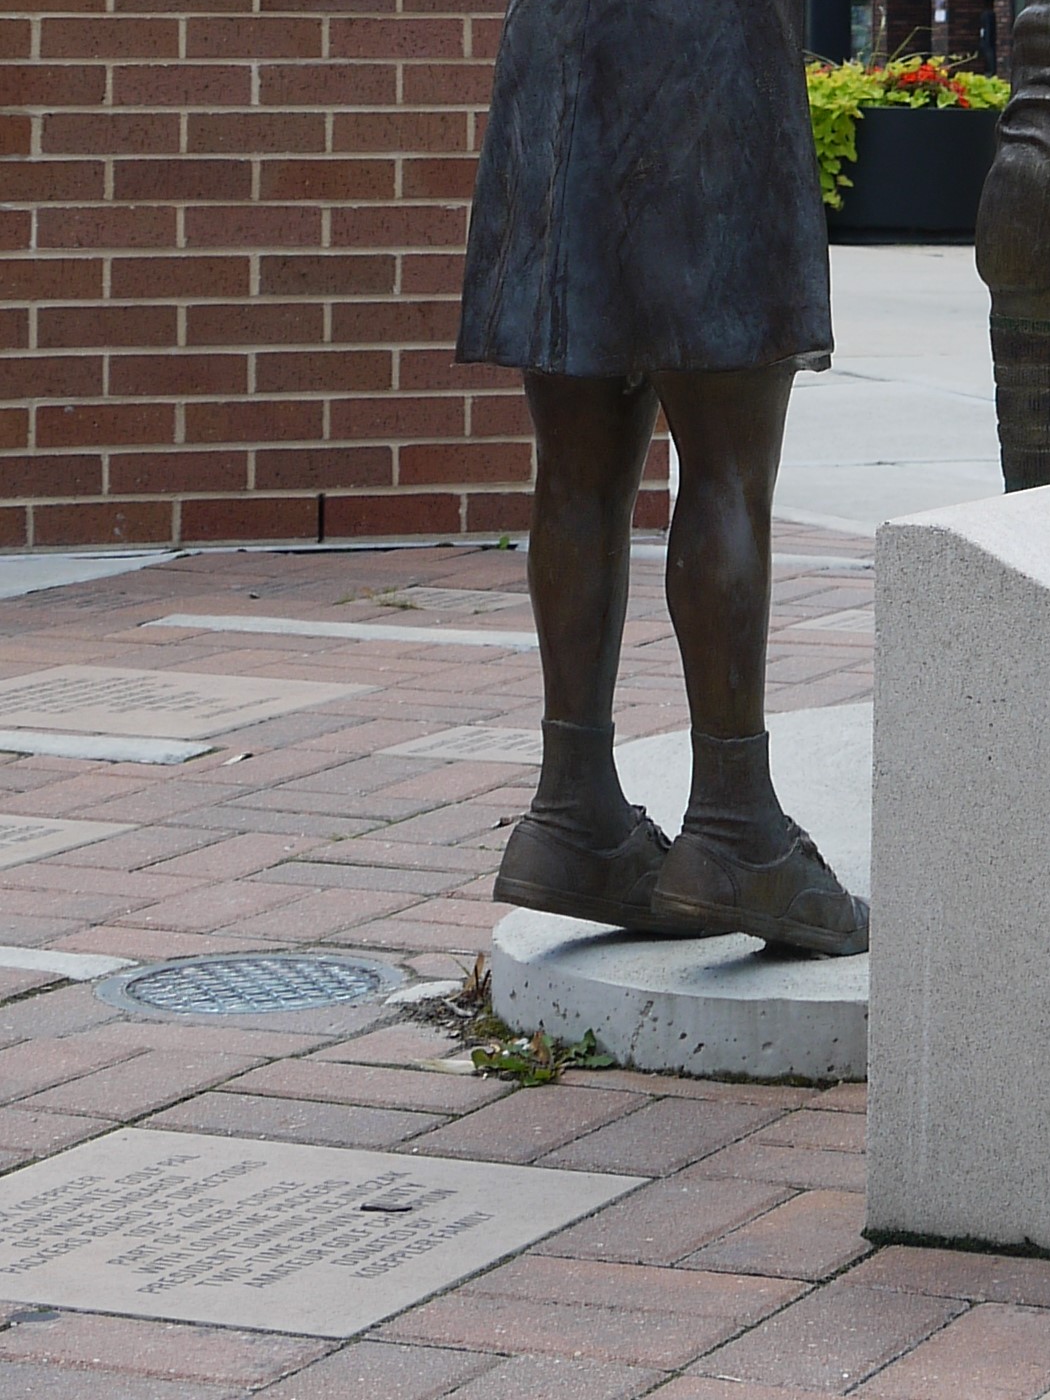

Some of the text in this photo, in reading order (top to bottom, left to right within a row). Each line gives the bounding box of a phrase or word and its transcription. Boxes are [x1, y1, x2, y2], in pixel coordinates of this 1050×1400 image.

[9, 1175, 106, 1211] KOEPPLER
[12, 1236, 47, 1249] OF
[37, 1211, 104, 1237] VINCE
[92, 1175, 191, 1213] LOMBARDI
[115, 1166, 166, 1186] GOLF
[0, 1159, 268, 1275] PACKERS BOARD OF DIRECTORS
[105, 1180, 307, 1266] PART OF INNER-CIRCLE
[132, 1179, 350, 1275] WITH LONGTIME PACKERS
[136, 1248, 243, 1294] PRESIDENT
[233, 1214, 318, 1249] DOMINIC
[195, 1243, 295, 1287] TWO-TIME
[288, 1212, 365, 1244] BROWN
[331, 1230, 417, 1266] DONATED
[349, 1211, 495, 1279] KOEPPLER FAMILY
[243, 1249, 335, 1289] AMATEUR
[322, 1228, 373, 1249] GOLF
